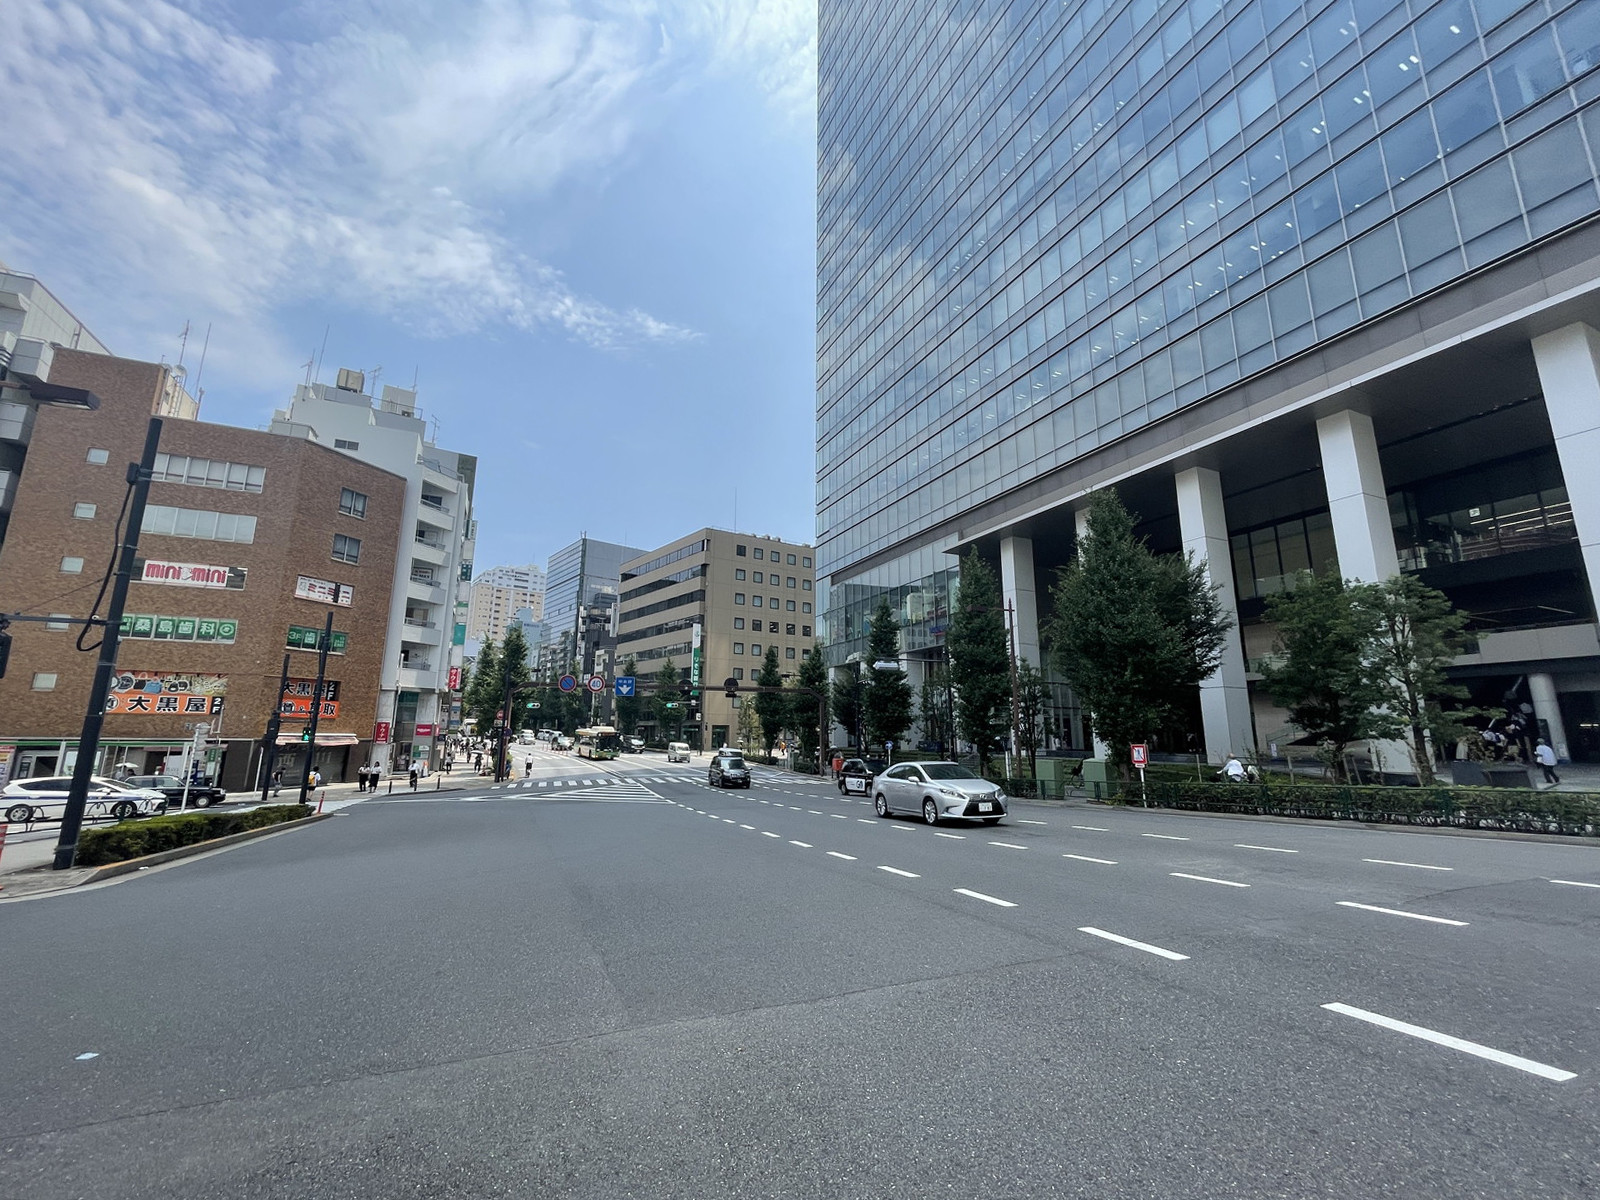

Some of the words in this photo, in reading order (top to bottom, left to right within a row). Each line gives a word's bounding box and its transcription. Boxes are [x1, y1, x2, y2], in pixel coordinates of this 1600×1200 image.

[134, 618, 216, 635] 桑島歯科
[288, 631, 302, 640] 3F
[592, 680, 601, 688] 40
[127, 695, 207, 713] 大黒屋
